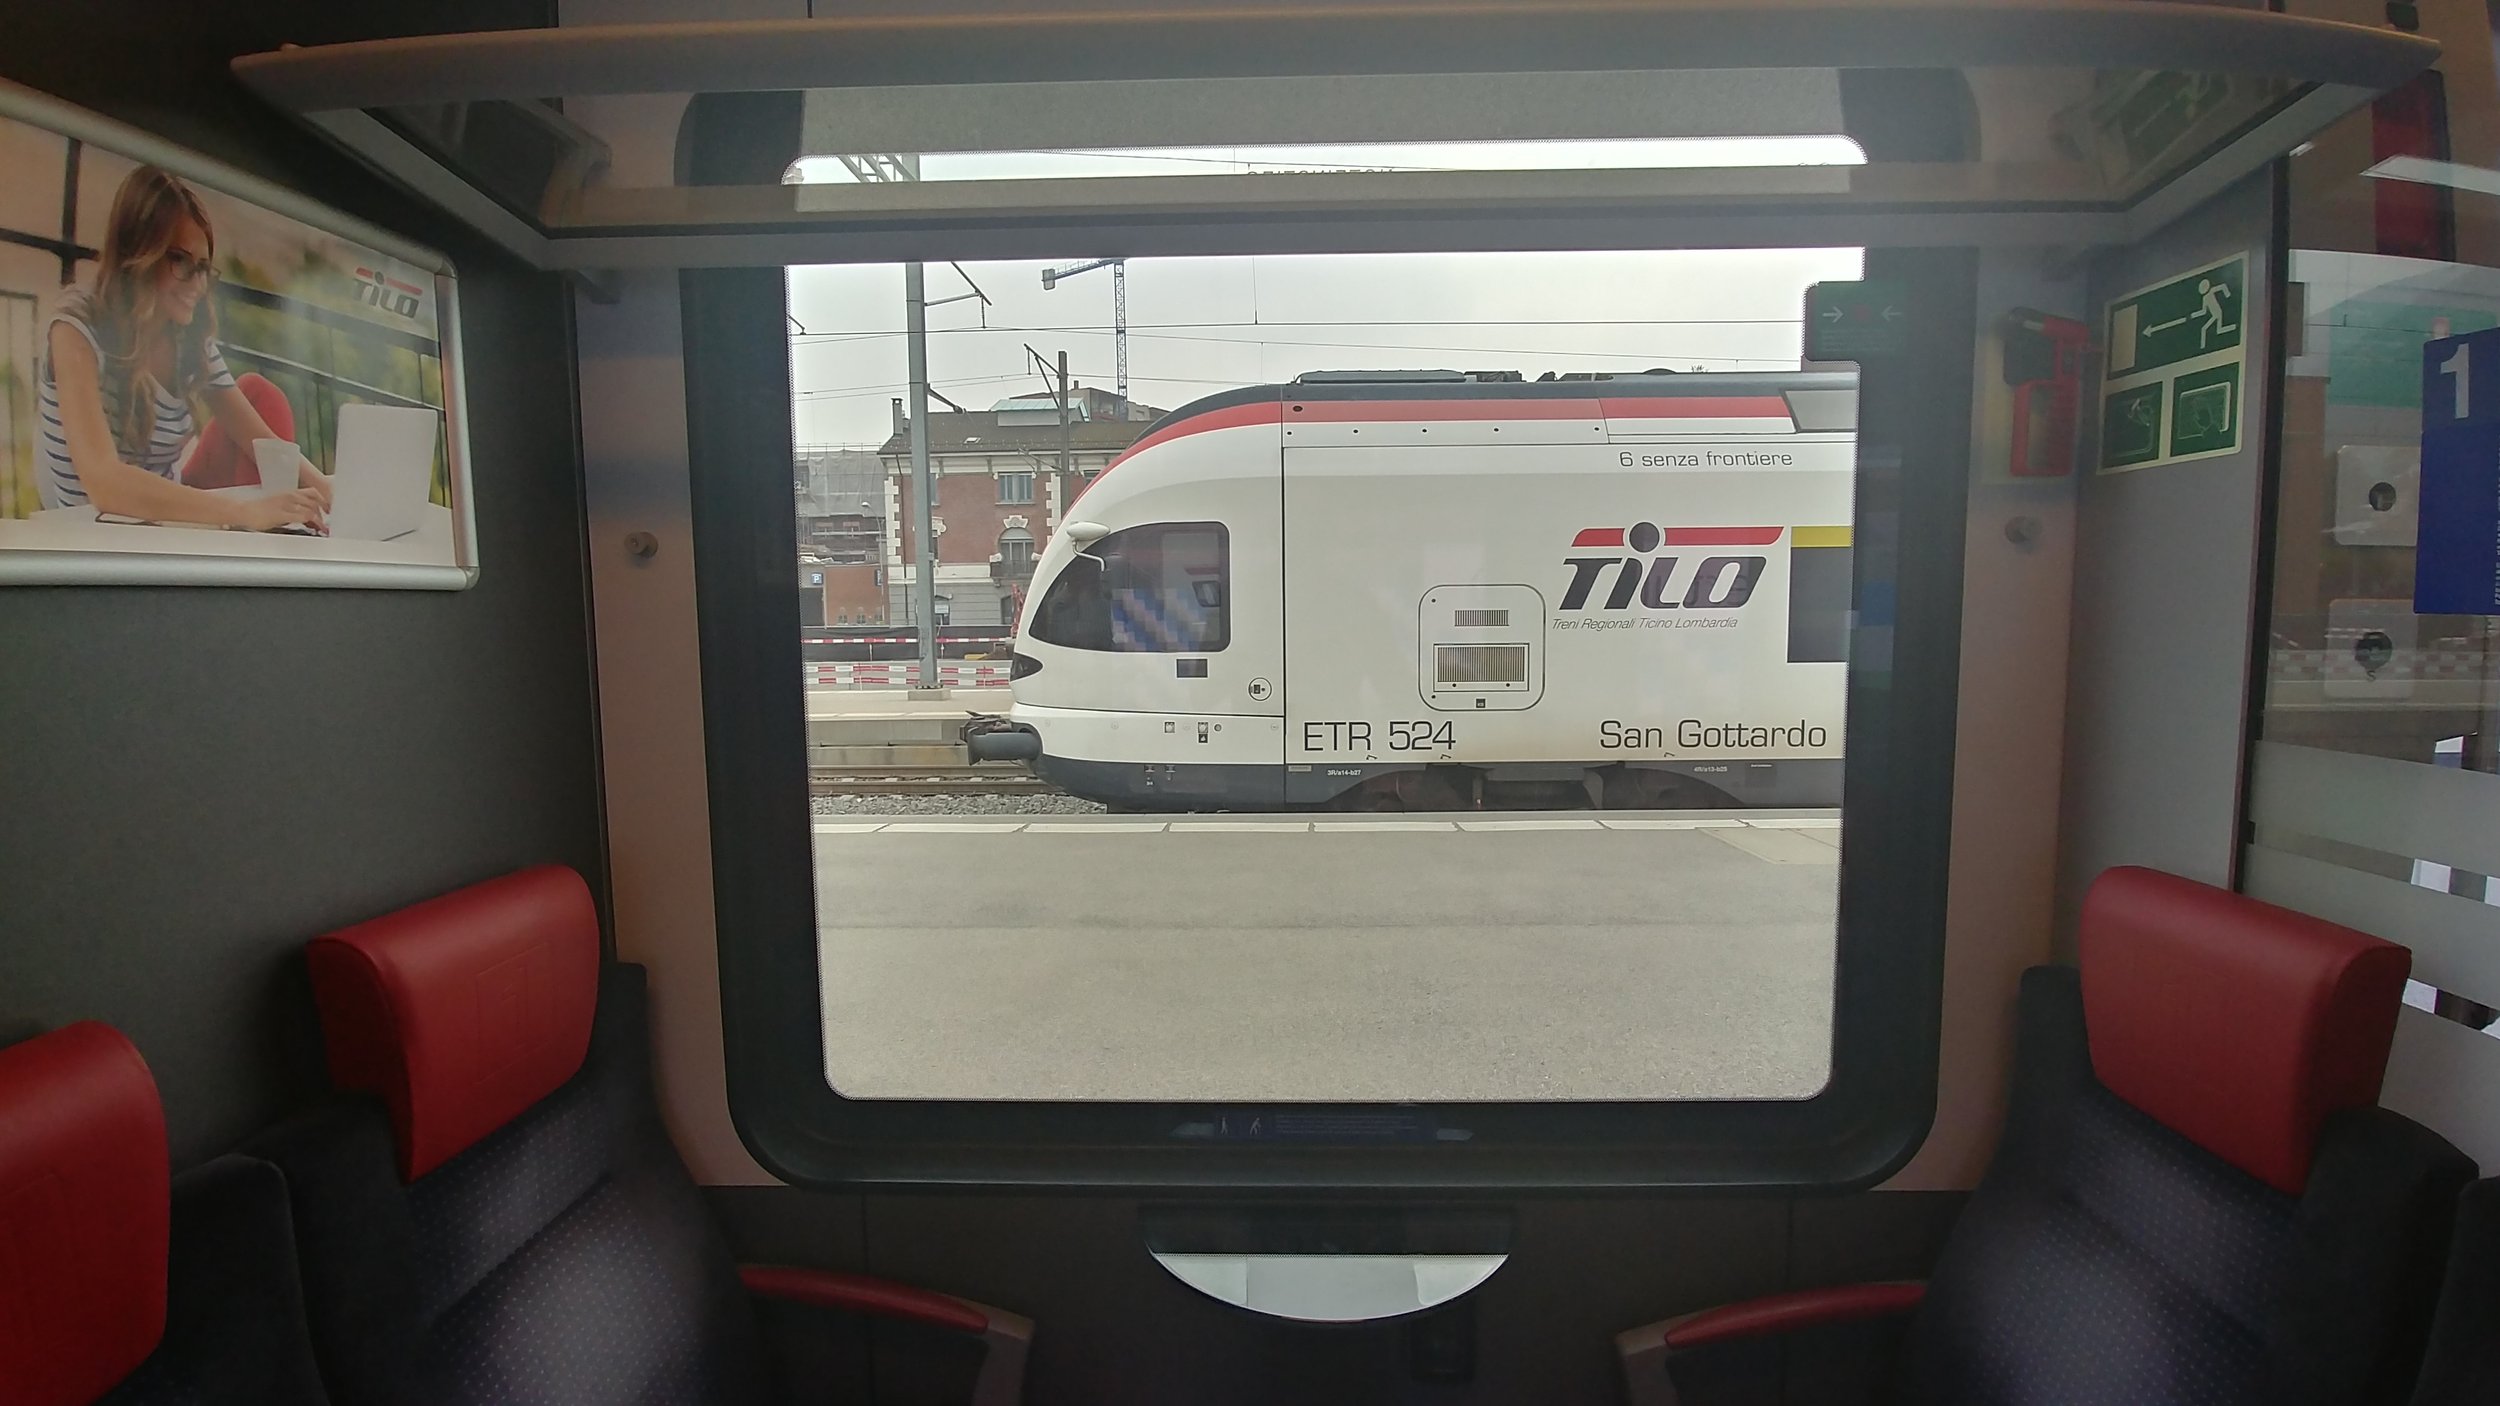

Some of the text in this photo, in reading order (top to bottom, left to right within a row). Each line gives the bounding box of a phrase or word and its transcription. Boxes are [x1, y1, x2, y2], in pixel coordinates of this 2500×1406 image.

[2440, 343, 2470, 419] 1
[1619, 450, 1793, 467] 6 senza frontiere
[1552, 616, 1739, 632] Treni Regionali Ticino Lombardia
[1304, 720, 1456, 751] ETR 524
[1600, 719, 1827, 748] San Gottardo
